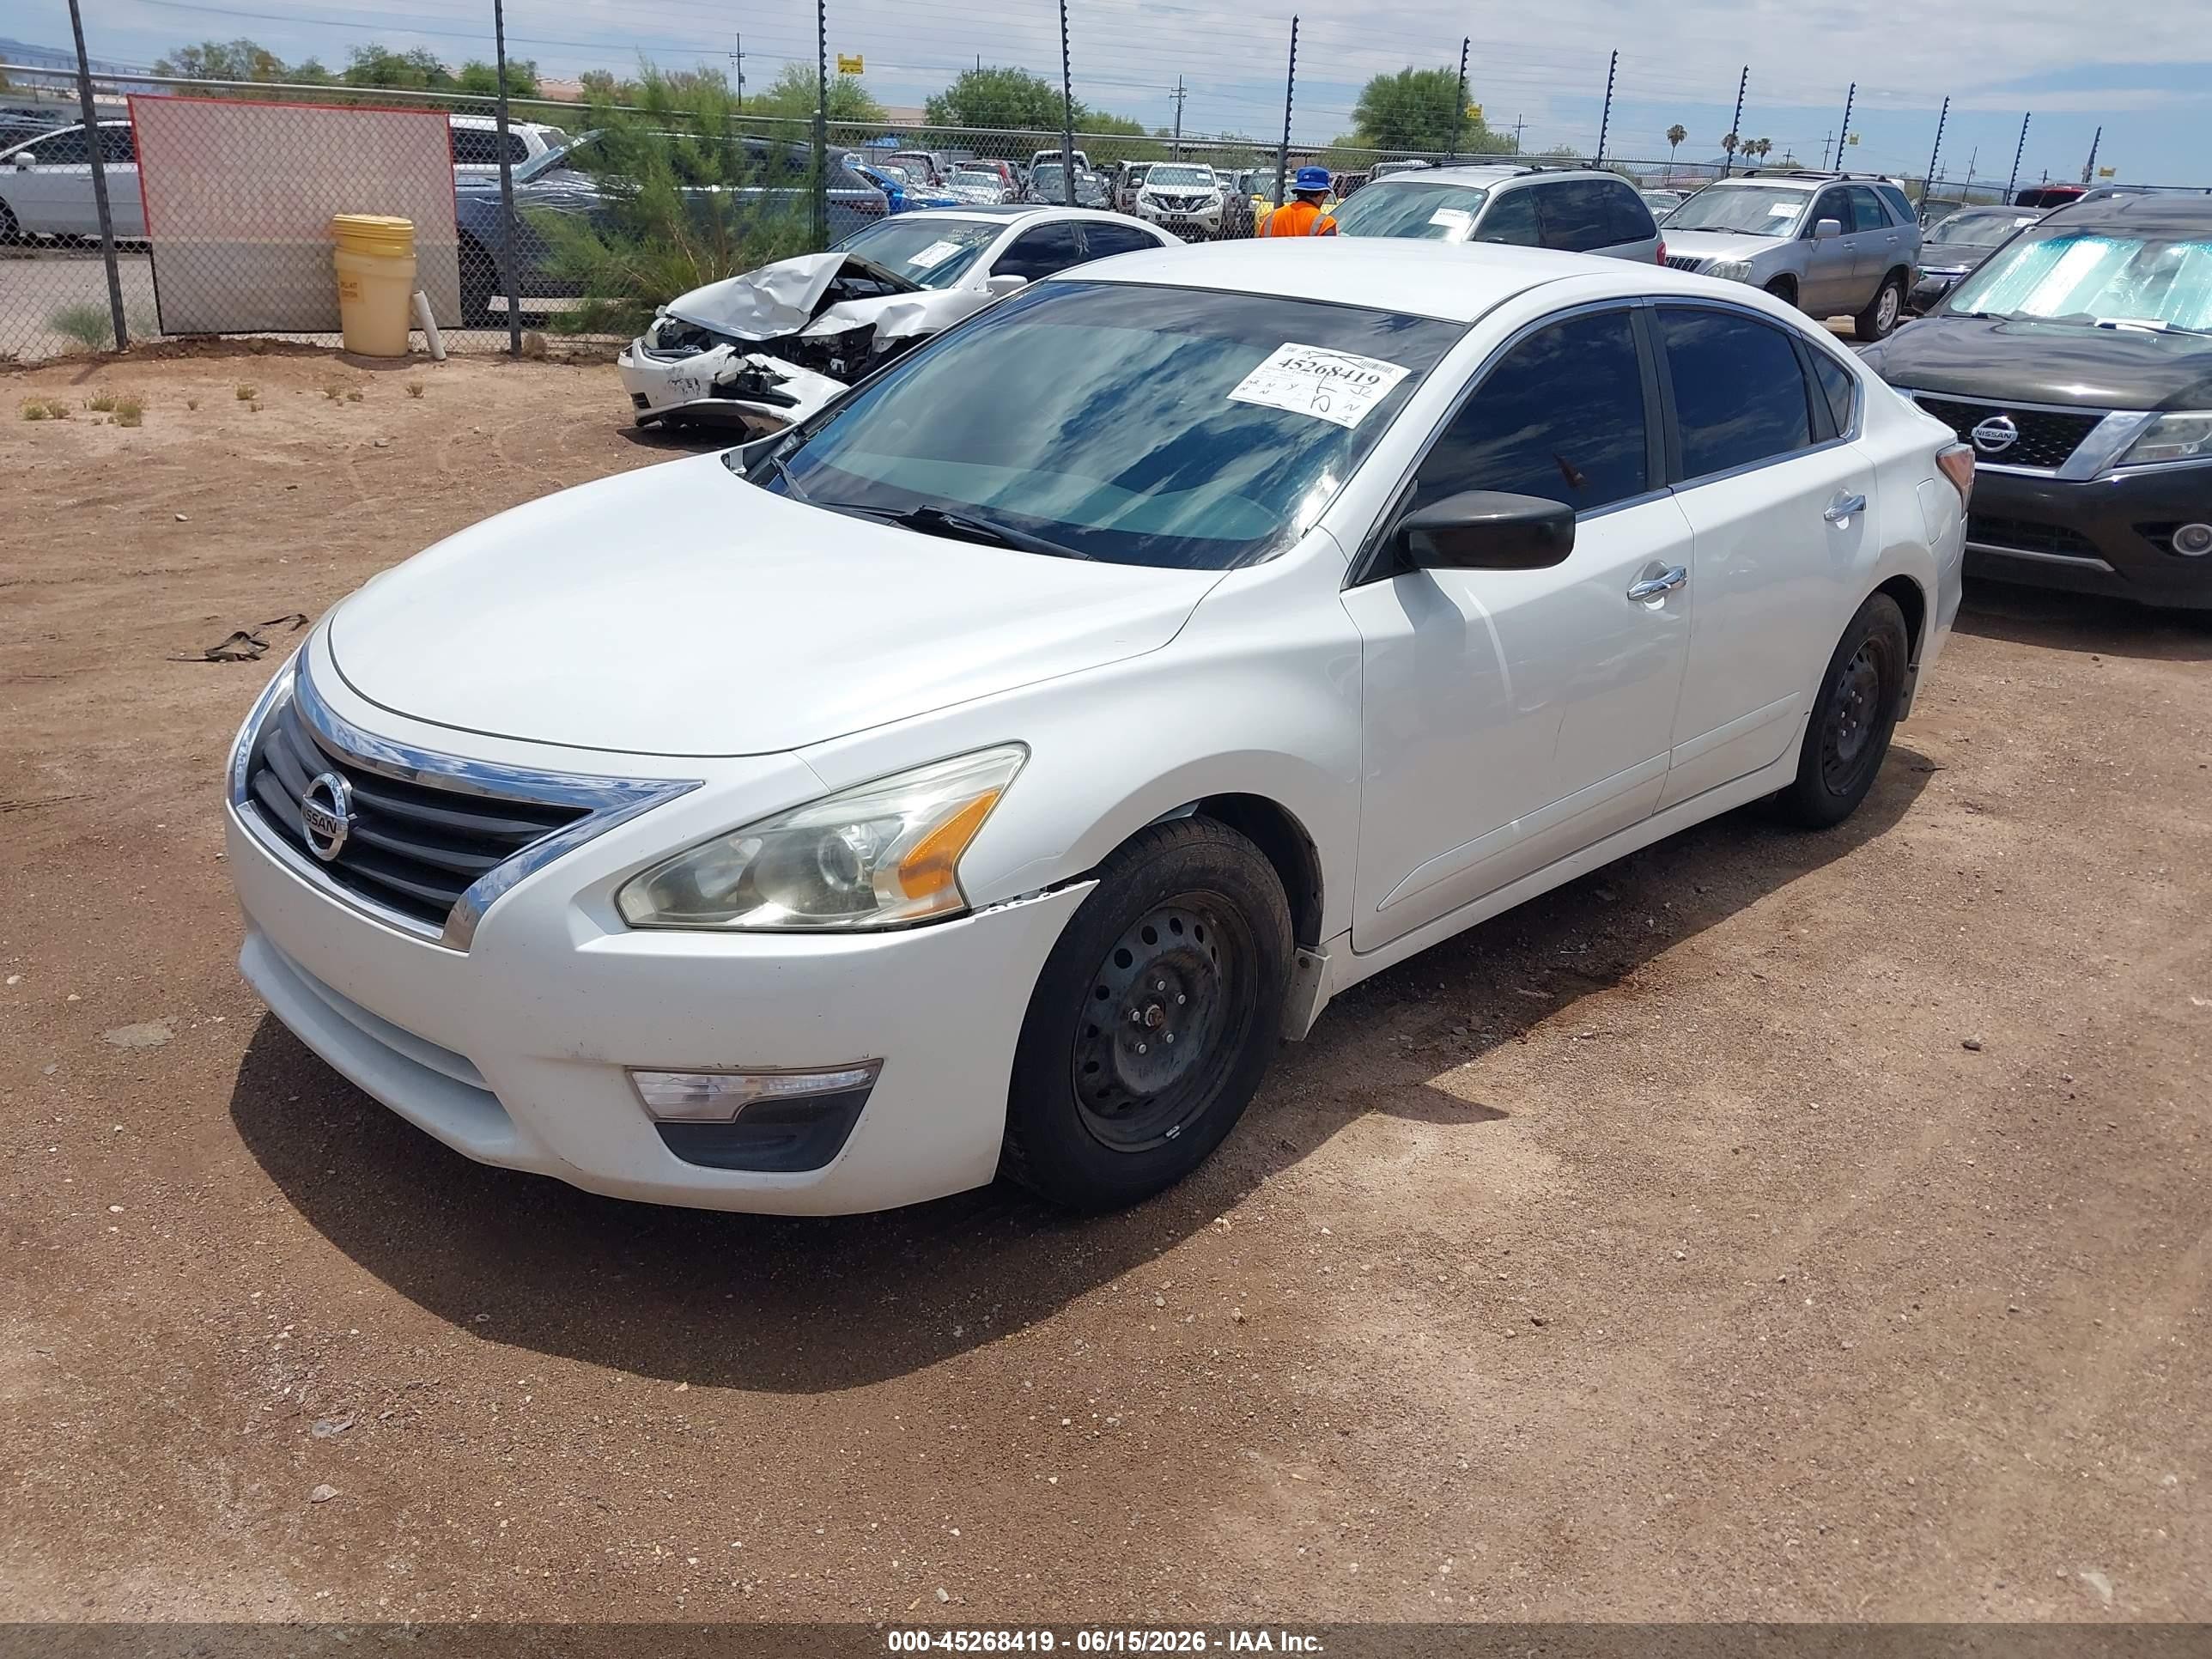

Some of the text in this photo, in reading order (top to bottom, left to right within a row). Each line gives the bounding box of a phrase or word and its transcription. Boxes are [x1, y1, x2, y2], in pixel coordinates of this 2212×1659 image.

[1278, 357, 1381, 386] 45268419
[1975, 429, 2012, 440] NISSAN
[302, 804, 337, 835] ISSAN
